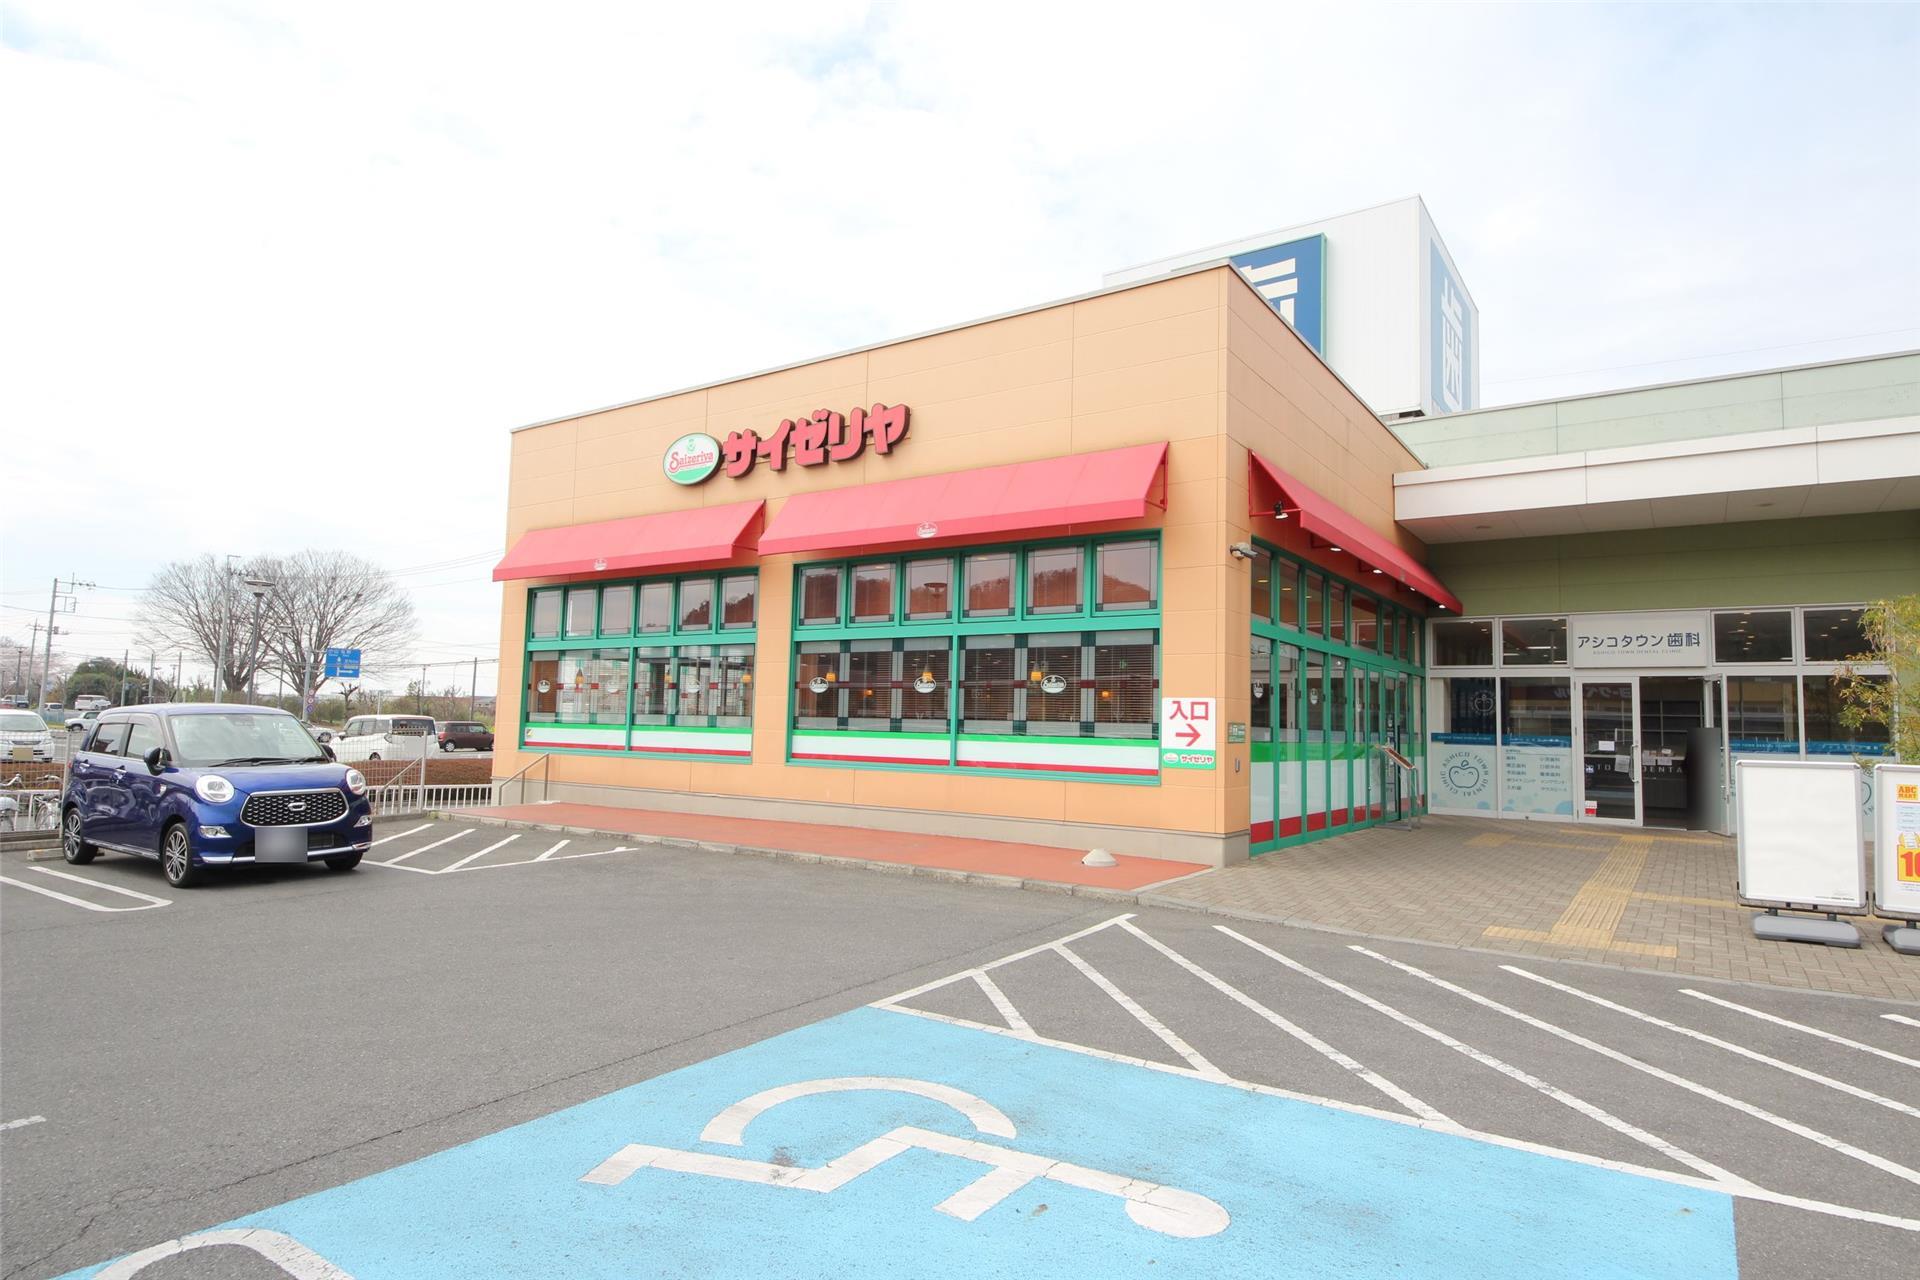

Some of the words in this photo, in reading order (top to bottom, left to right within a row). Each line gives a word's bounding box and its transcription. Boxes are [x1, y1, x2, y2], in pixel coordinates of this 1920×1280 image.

[1440, 277, 1463, 412] 歯
[723, 403, 909, 478] サイゼリヤ
[668, 451, 714, 473] Saizeriya
[1577, 632, 1701, 648] アシコタウン歯科
[1169, 700, 1209, 721] 入口
[1181, 755, 1213, 764] サイゼリヤ
[1442, 751, 1470, 769] ASHICO
[1473, 754, 1489, 776] TOWN
[1440, 770, 1459, 795] CLINIC
[1463, 778, 1489, 797] DENTAL
[1898, 785, 1917, 794] ABC
